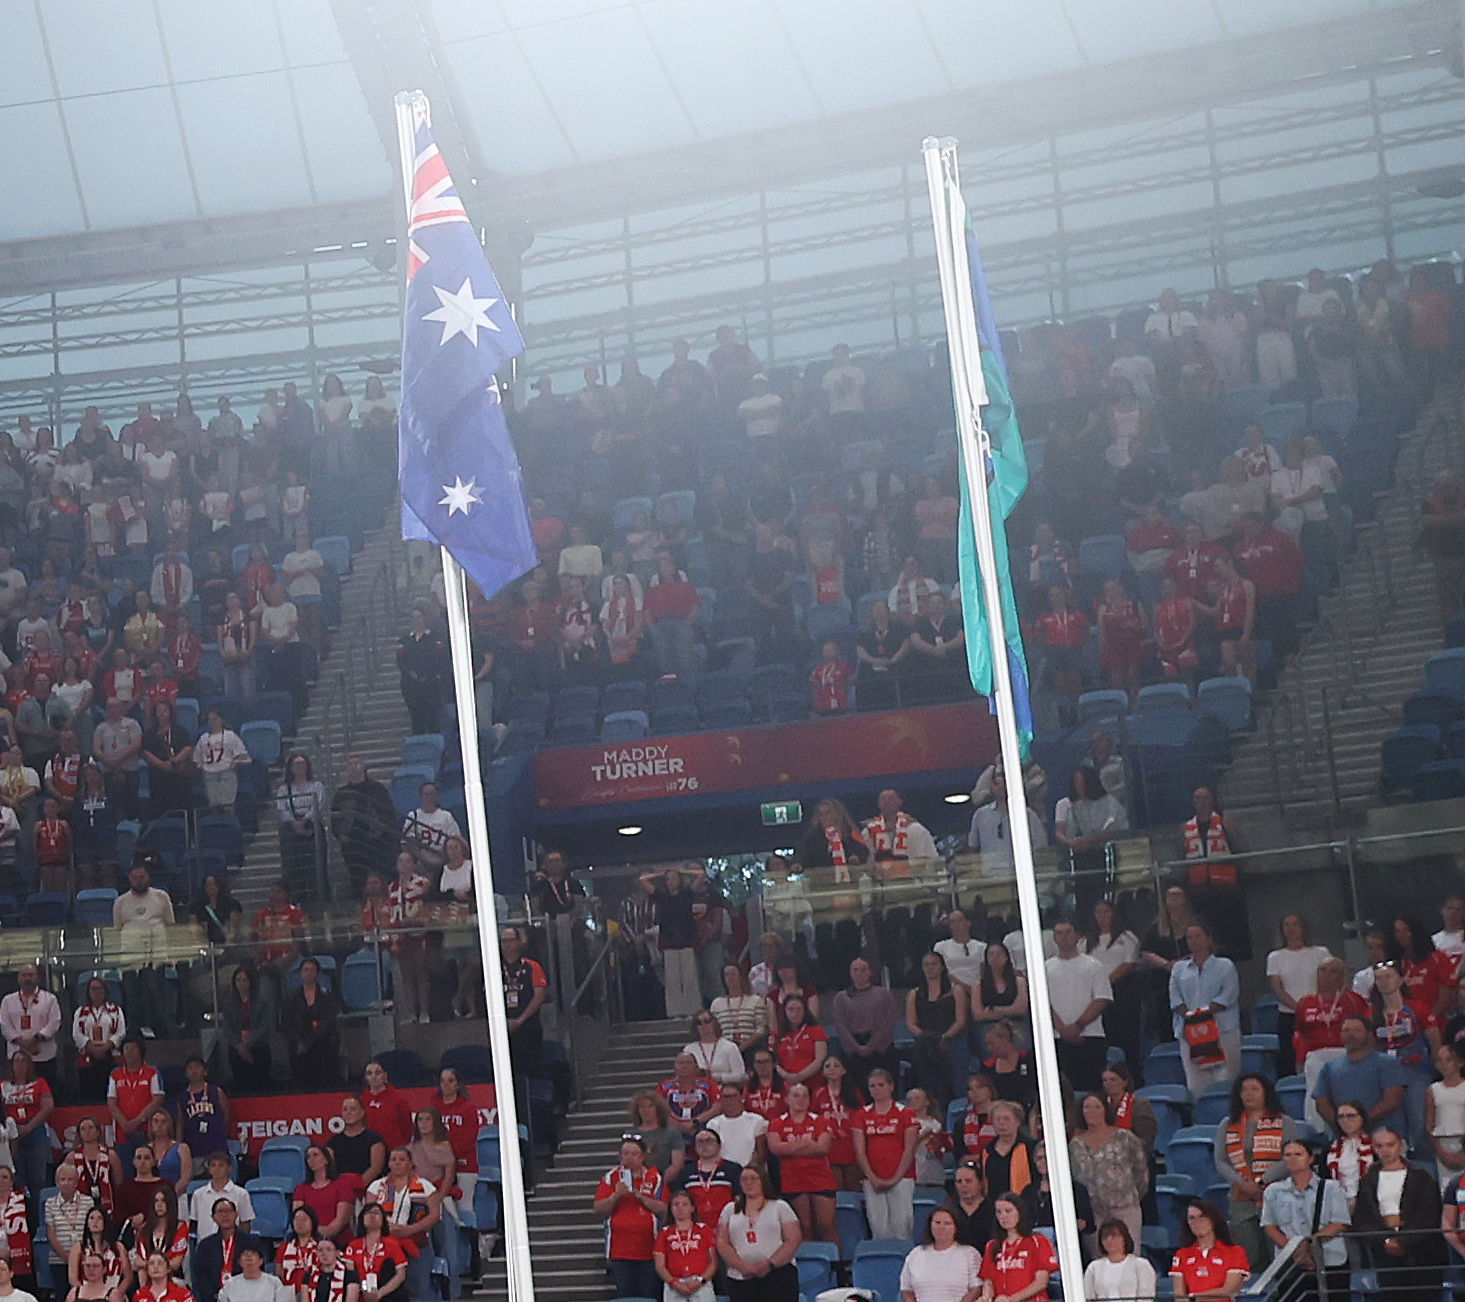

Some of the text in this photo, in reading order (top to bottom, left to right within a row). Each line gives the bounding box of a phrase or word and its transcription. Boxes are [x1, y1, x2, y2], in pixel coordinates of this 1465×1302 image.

[603, 744, 669, 764] MADDY
[591, 757, 684, 782] TURNER
[237, 1117, 324, 1140] TEIGAN
